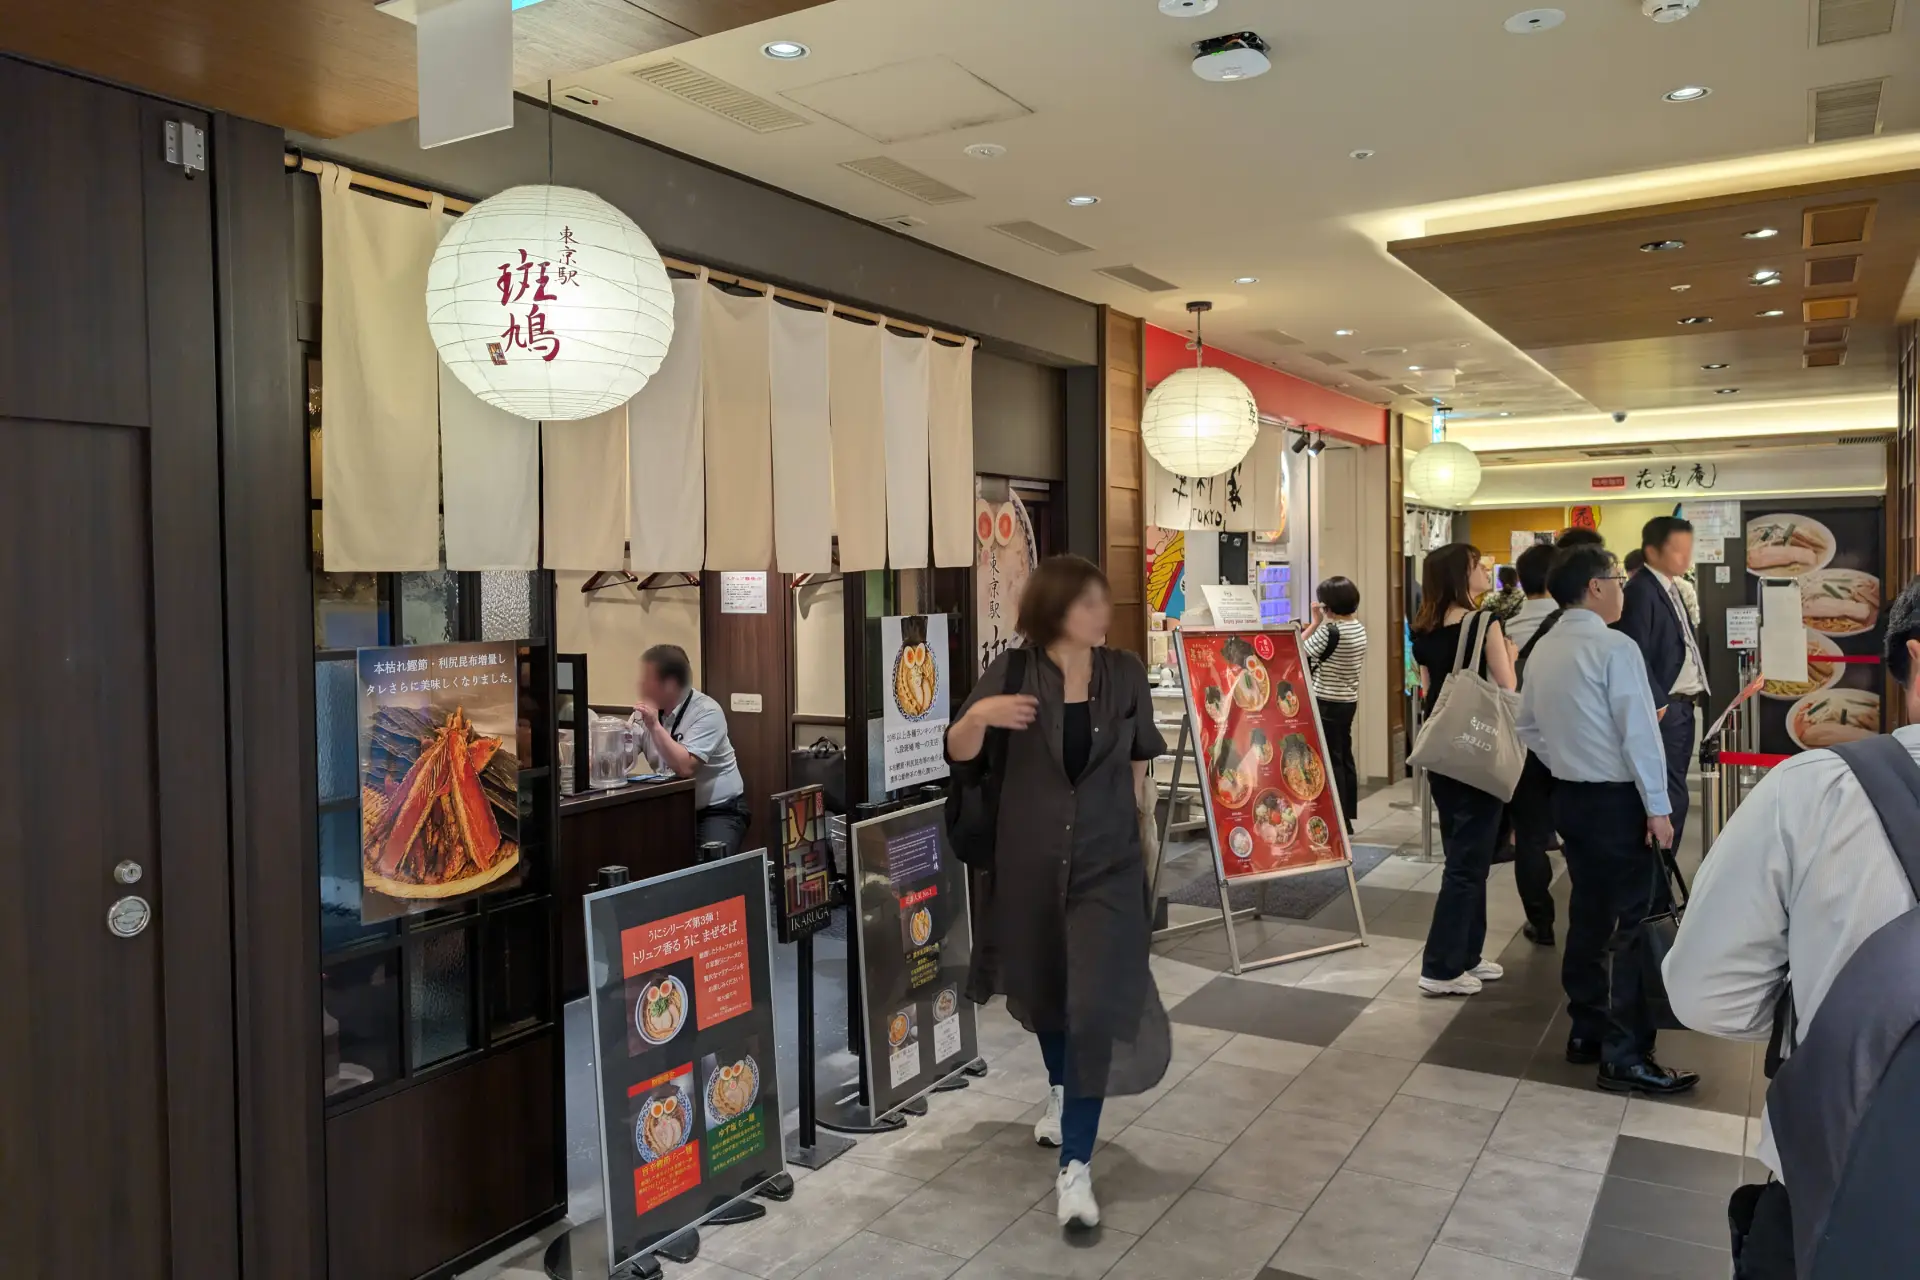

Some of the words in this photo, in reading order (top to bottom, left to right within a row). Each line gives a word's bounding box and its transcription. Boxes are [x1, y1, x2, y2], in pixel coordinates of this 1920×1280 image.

[555, 225, 580, 287] 東京駅
[496, 248, 561, 362] 斑鳩
[1636, 463, 1717, 489] 花道庵
[1192, 508, 1222, 527] TOKYO
[989, 553, 1001, 619] 東京駅
[366, 672, 513, 696] タレさらに美味しくなりました。
[791, 906, 829, 931] IKARUGA
[632, 939, 681, 966] トリュフ香る
[683, 934, 700, 950] うに
[702, 920, 738, 943] まぜそば
